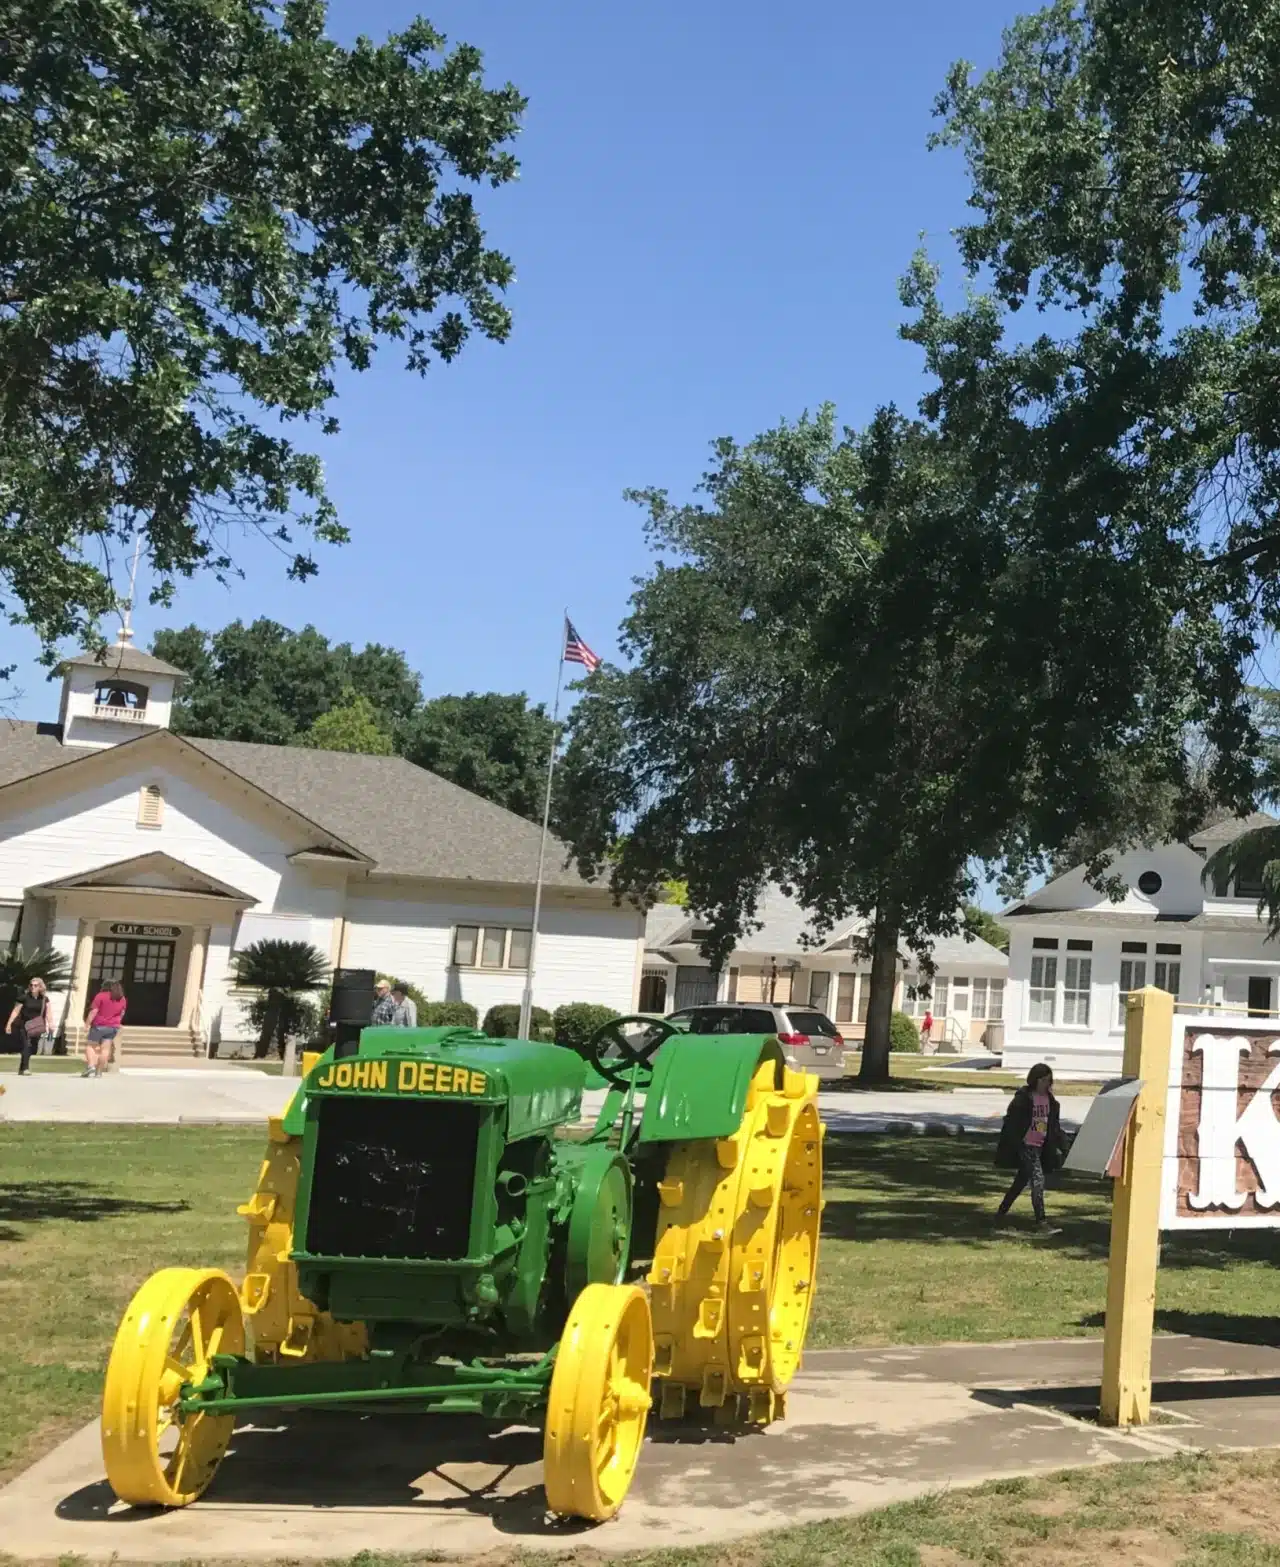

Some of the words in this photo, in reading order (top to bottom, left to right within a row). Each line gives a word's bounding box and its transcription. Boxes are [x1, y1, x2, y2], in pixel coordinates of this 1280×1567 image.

[117, 924, 138, 934] CLAY
[143, 926, 174, 936] SCHOOL
[318, 1061, 388, 1089] JOHN
[398, 1061, 487, 1094] DEERE
